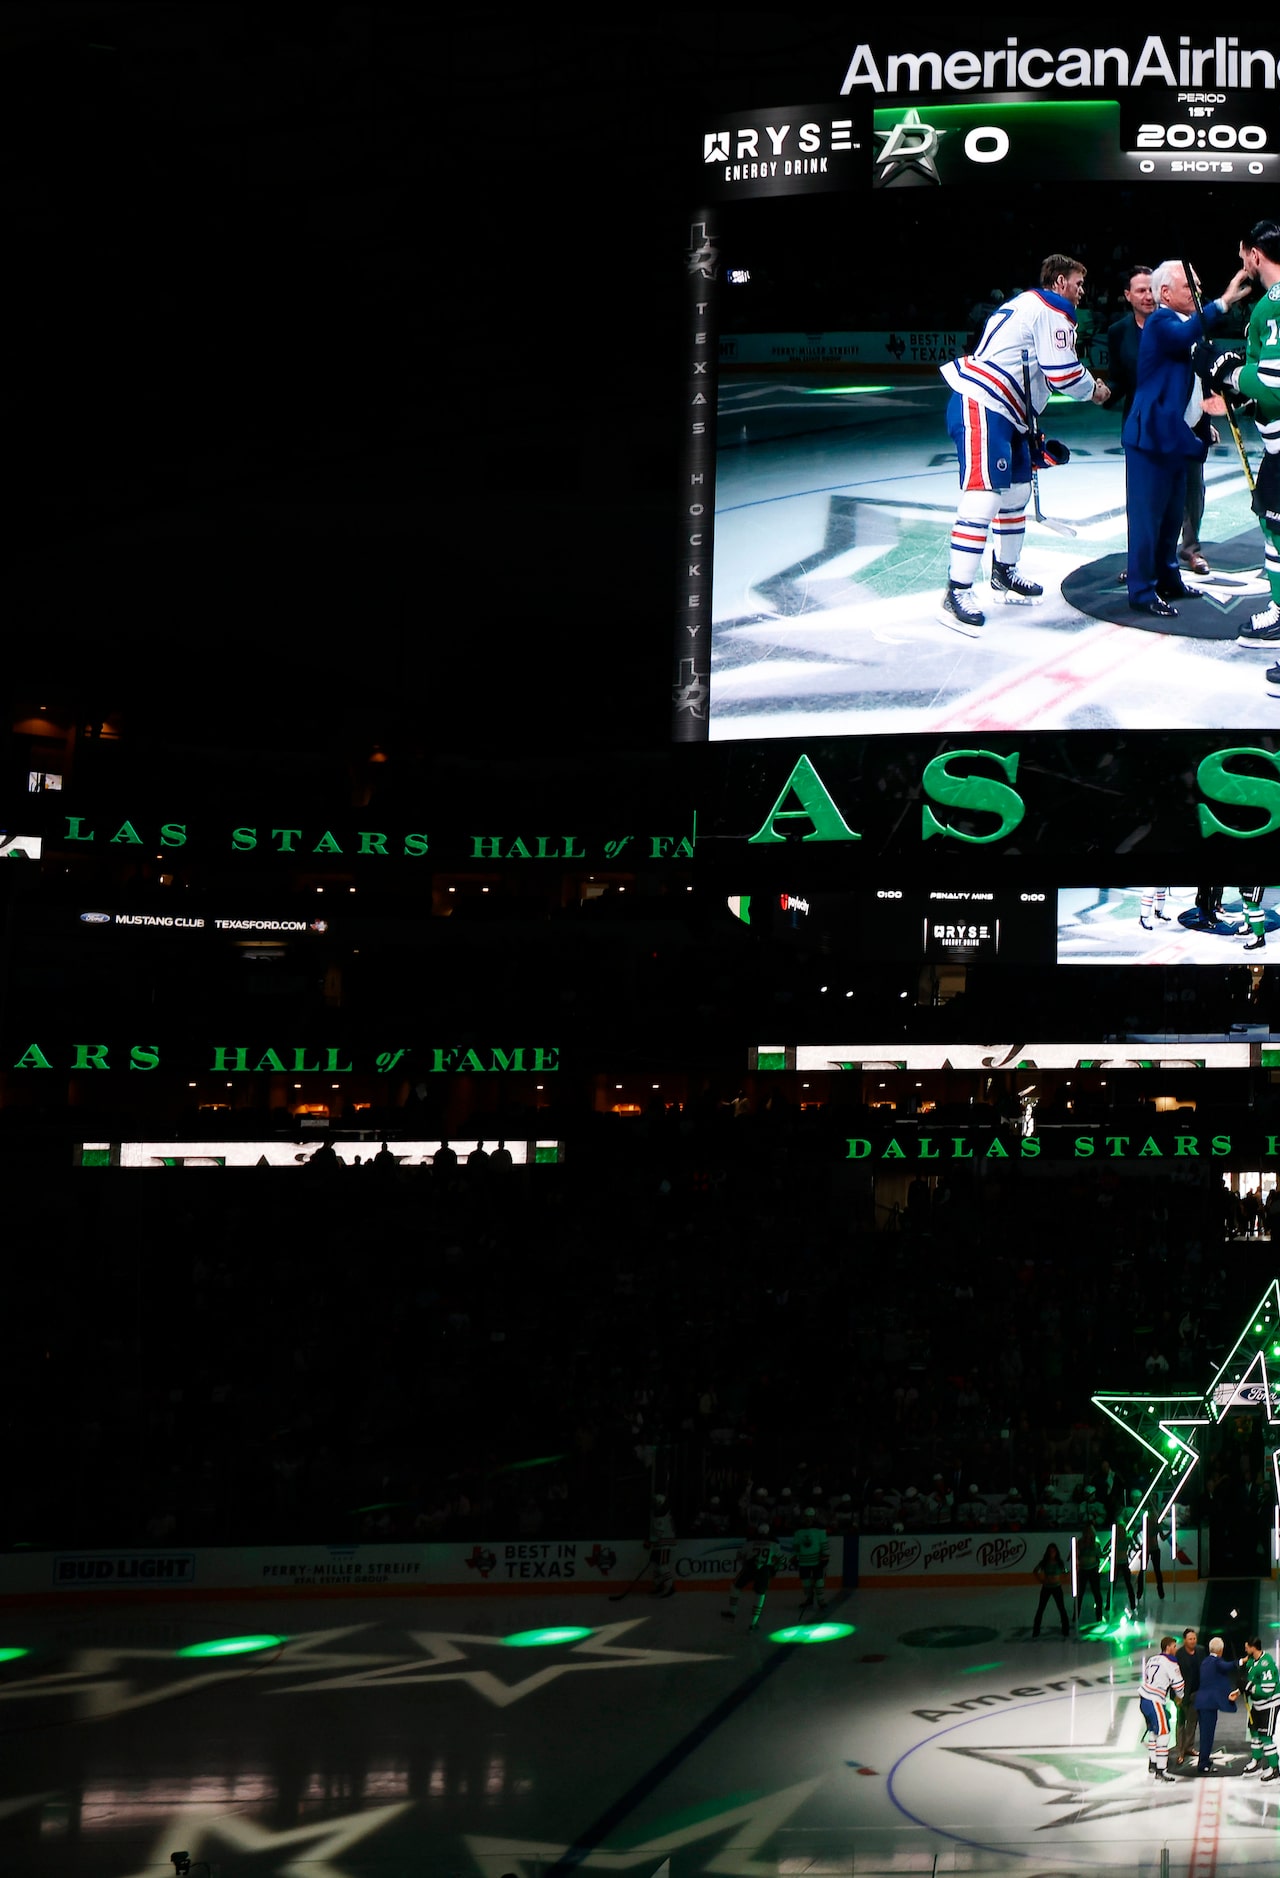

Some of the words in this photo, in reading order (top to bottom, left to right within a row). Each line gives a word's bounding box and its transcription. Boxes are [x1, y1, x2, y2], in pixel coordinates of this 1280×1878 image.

[1177, 92, 1227, 104] PERIOD
[1188, 106, 1215, 118] 1ST
[736, 119, 854, 160] RYSE
[964, 125, 1010, 163] 0
[1136, 123, 1268, 150] 20:00
[724, 161, 778, 183] ENERGY
[784, 156, 829, 176] DRINK
[1139, 159, 1155, 174] 0
[1171, 160, 1234, 173] SHOTS
[1248, 161, 1264, 175] 0
[910, 333, 940, 346] BEST
[943, 334, 956, 346] IN
[691, 302, 709, 435] TEXAS
[687, 473, 704, 638] HOCKEY
[231, 827, 429, 858] STARS
[469, 836, 586, 858] HALL
[603, 836, 635, 860] of
[876, 890, 903, 899] 0:00
[930, 892, 970, 900] PENALTY
[971, 893, 994, 901] MINS
[1020, 893, 1046, 902] 0:00
[115, 914, 174, 927] MUSTANG
[175, 916, 205, 928] CLUB
[214, 919, 307, 931] TEXASFORD.COM
[210, 1047, 353, 1072] HALL
[375, 1047, 409, 1073] of
[429, 1047, 560, 1073] FAME
[845, 1136, 1041, 1159] DALLAS
[1074, 1135, 1232, 1157] STARS
[505, 1545, 551, 1559] BEST
[558, 1544, 577, 1559] IN
[889, 1539, 906, 1554] Dr
[923, 1537, 973, 1570] pepper
[982, 1542, 1023, 1568] Pepper
[994, 1538, 1012, 1552] Dr
[675, 1556, 737, 1577] Comer
[875, 1543, 918, 1569] Pepper
[59, 1561, 113, 1579] BUD
[118, 1559, 190, 1578] LIGHT
[262, 1563, 363, 1577] PERRY-MILLER
[367, 1562, 421, 1575] STREIFF
[505, 1560, 576, 1578] TEXAS
[1262, 1669, 1273, 1681] 14
[910, 1672, 1142, 1723] Americ
